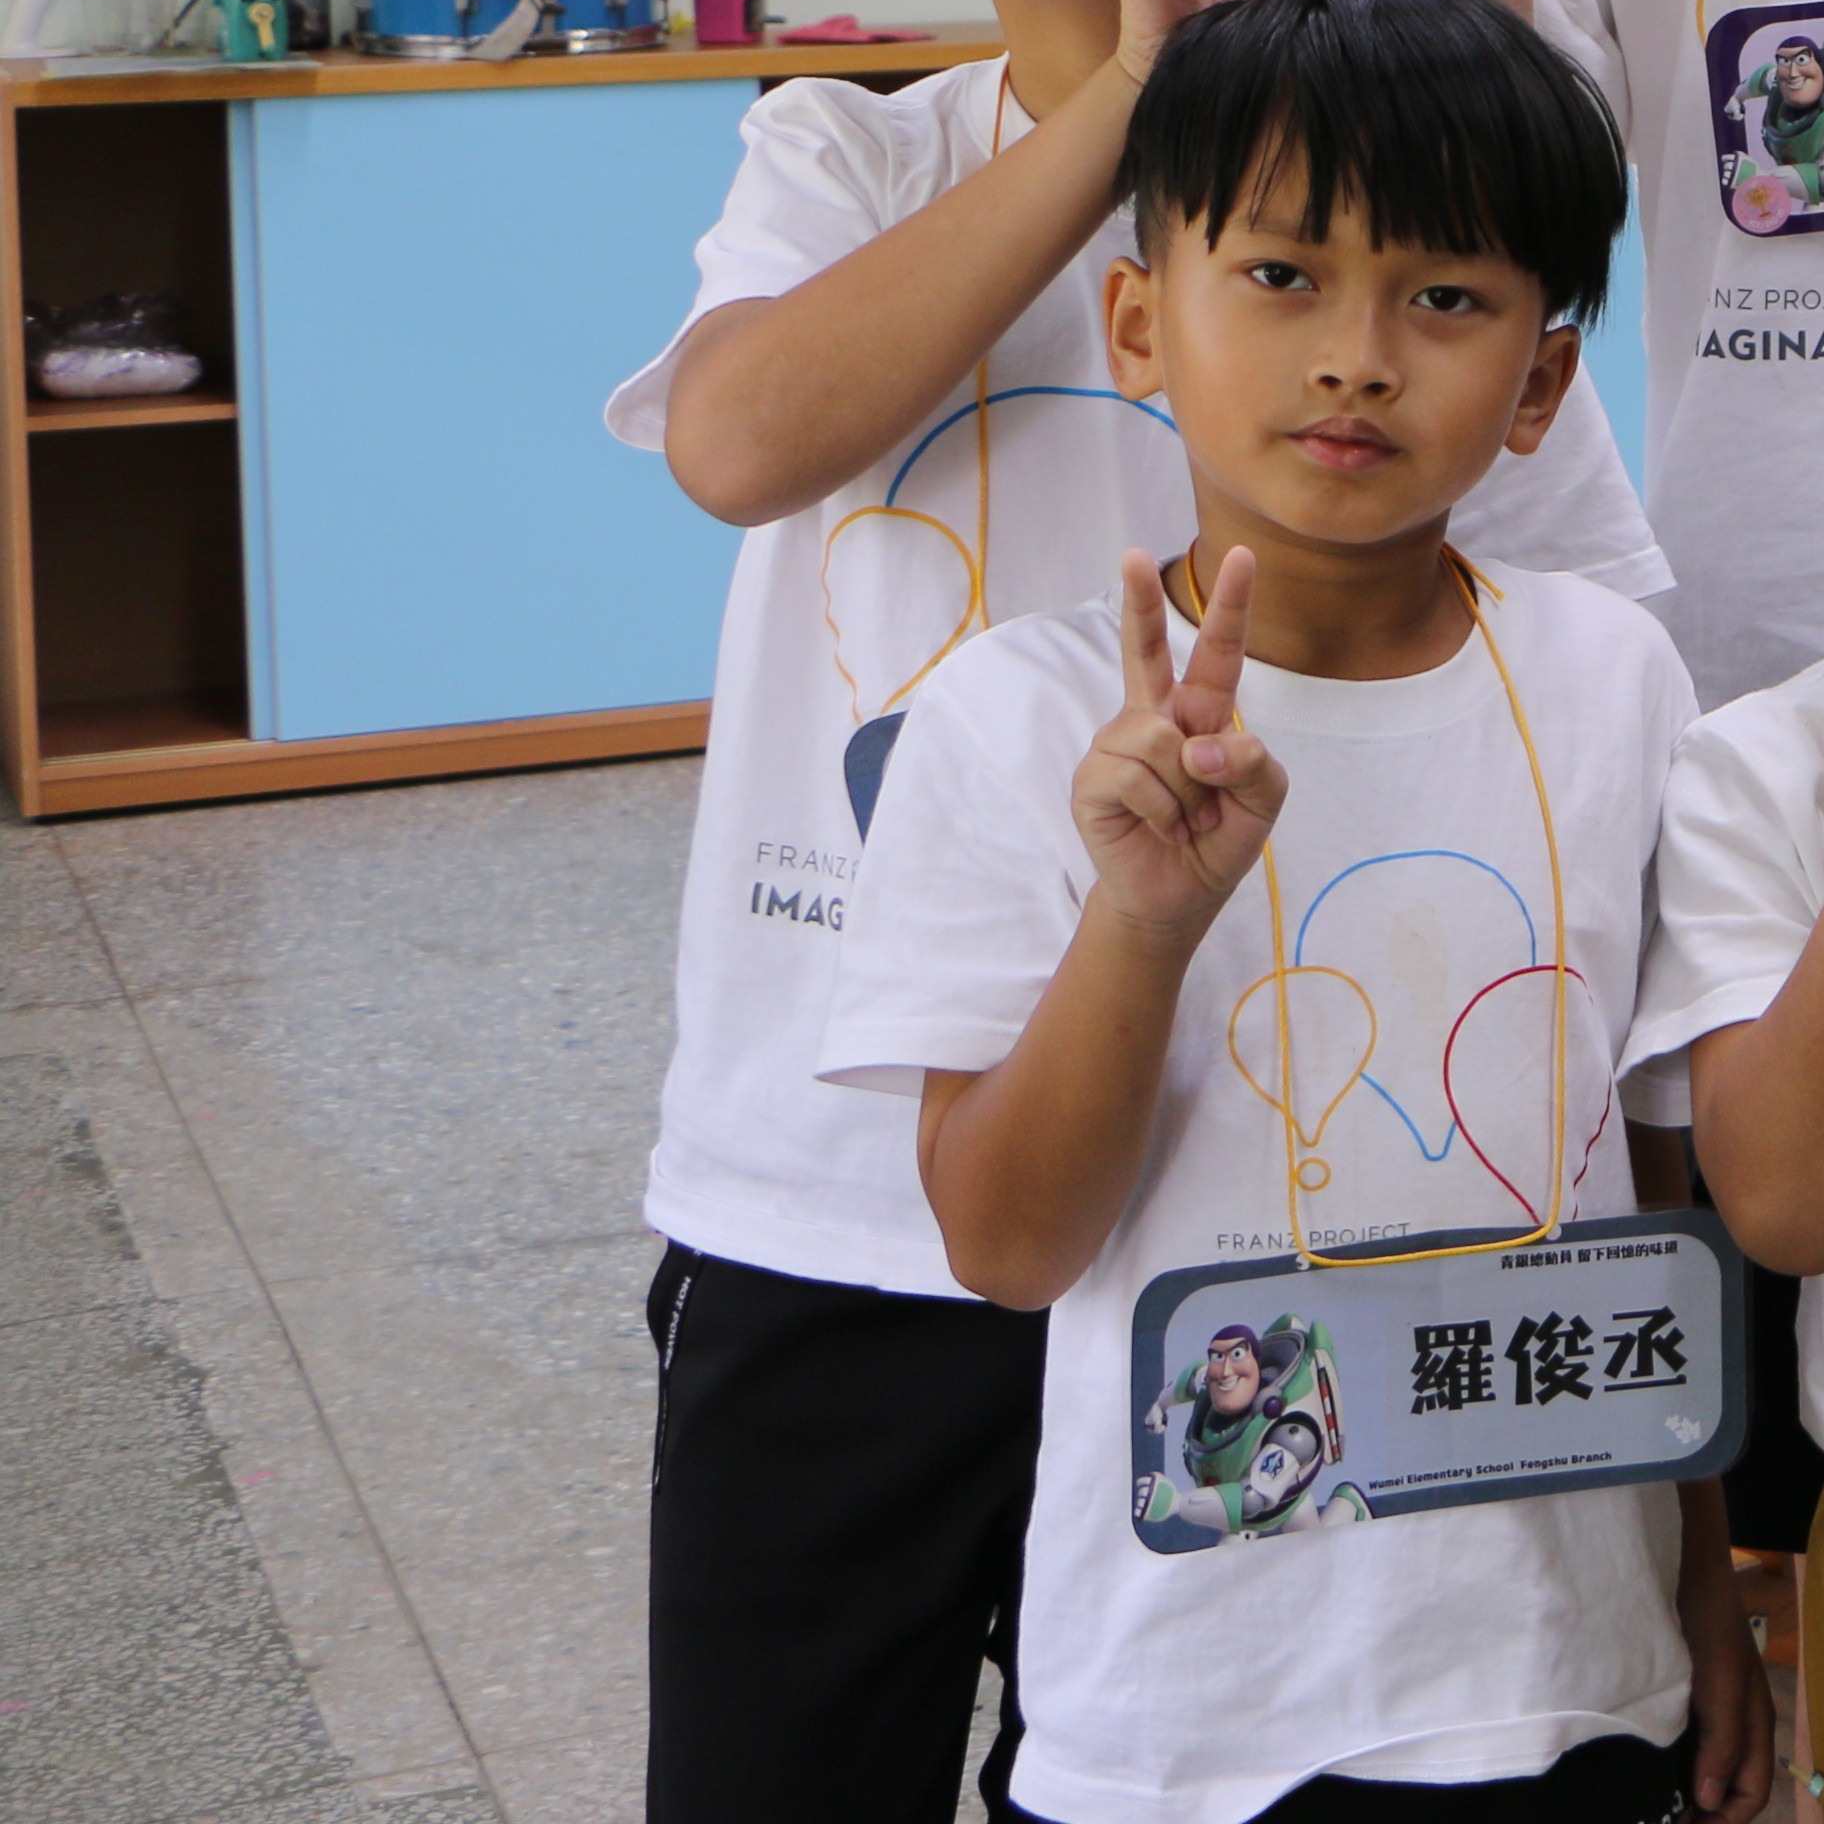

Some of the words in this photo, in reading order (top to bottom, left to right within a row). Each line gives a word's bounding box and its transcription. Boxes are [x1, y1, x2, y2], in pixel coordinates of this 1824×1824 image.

[756, 841, 847, 879] FRANZ
[1217, 1231, 1298, 1250] FRANZ
[1410, 1305, 1688, 1415] 羅俊丞
[1369, 1475, 1404, 1490] Wumei
[1406, 1466, 1473, 1484] Elementary
[1476, 1461, 1514, 1475] School
[1520, 1457, 1569, 1470] Fengshu
[1571, 1451, 1612, 1464] Branch
